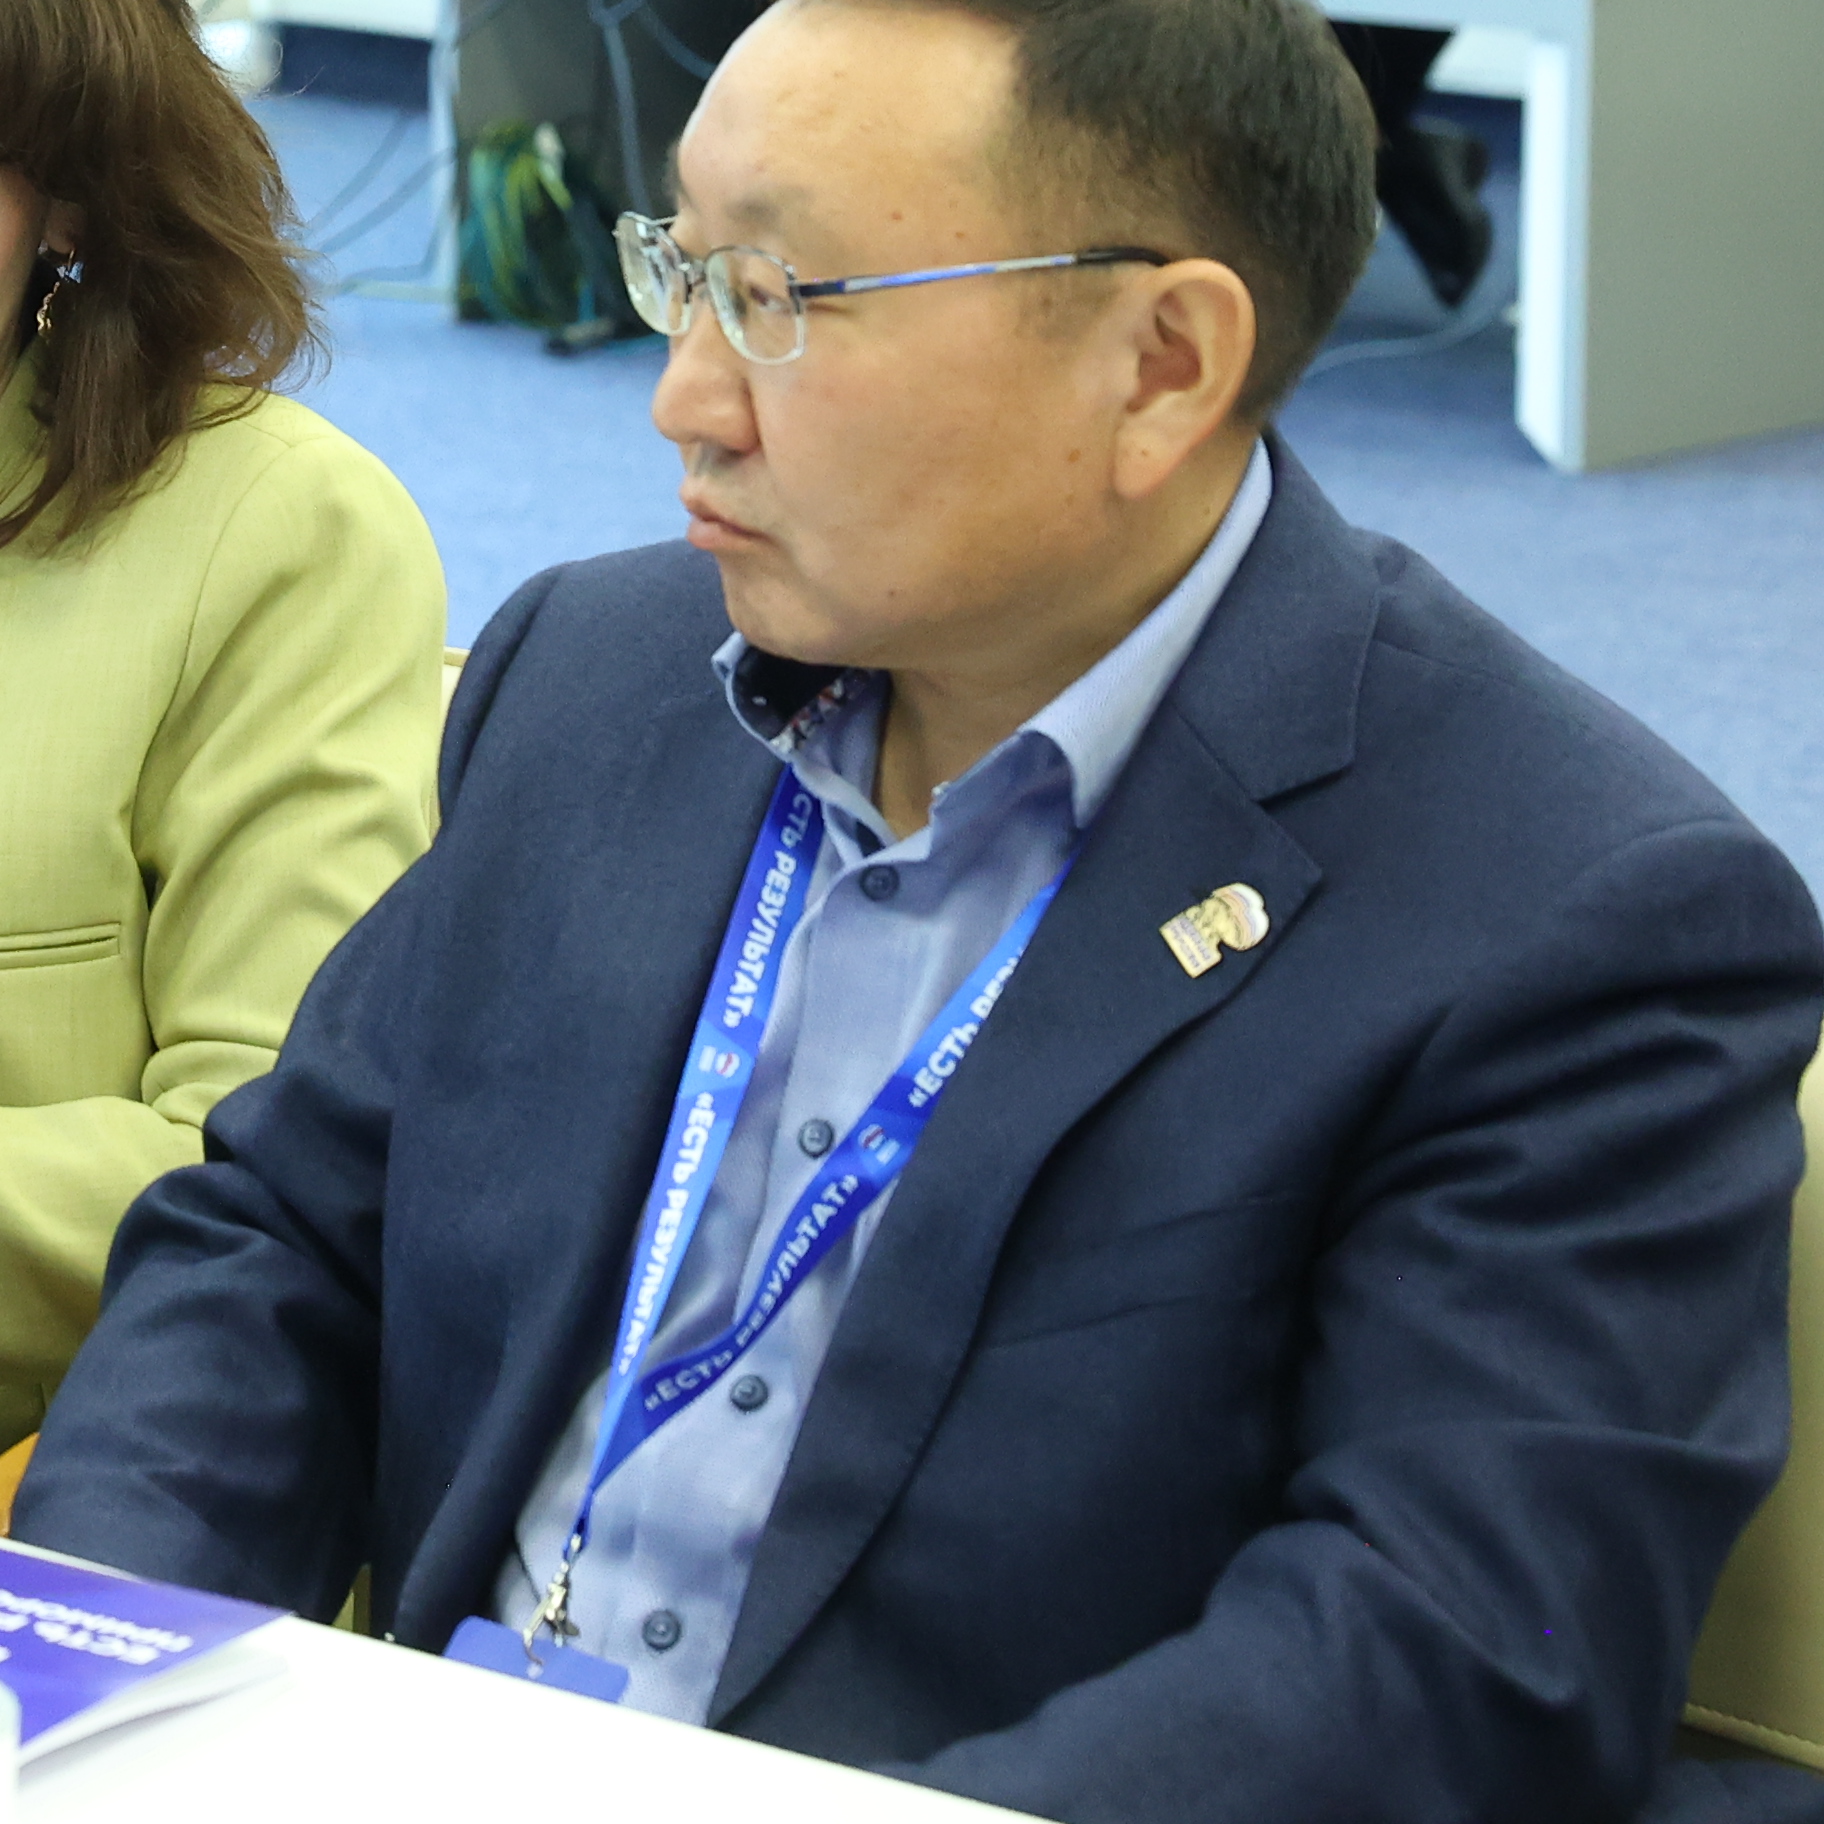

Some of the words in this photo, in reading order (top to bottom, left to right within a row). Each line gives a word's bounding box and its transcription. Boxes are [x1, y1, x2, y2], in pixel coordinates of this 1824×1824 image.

[780, 792, 813, 849] СТЬ
[722, 849, 798, 1029] РЕЗУЛЬТАТ»
[907, 1022, 979, 1108] «ЕСТЬ
[671, 1092, 716, 1185] «ЕСТЬ
[618, 1188, 690, 1376] РЕЗУЛЬТАТ»
[644, 1350, 733, 1412] «ЕСТЬ
